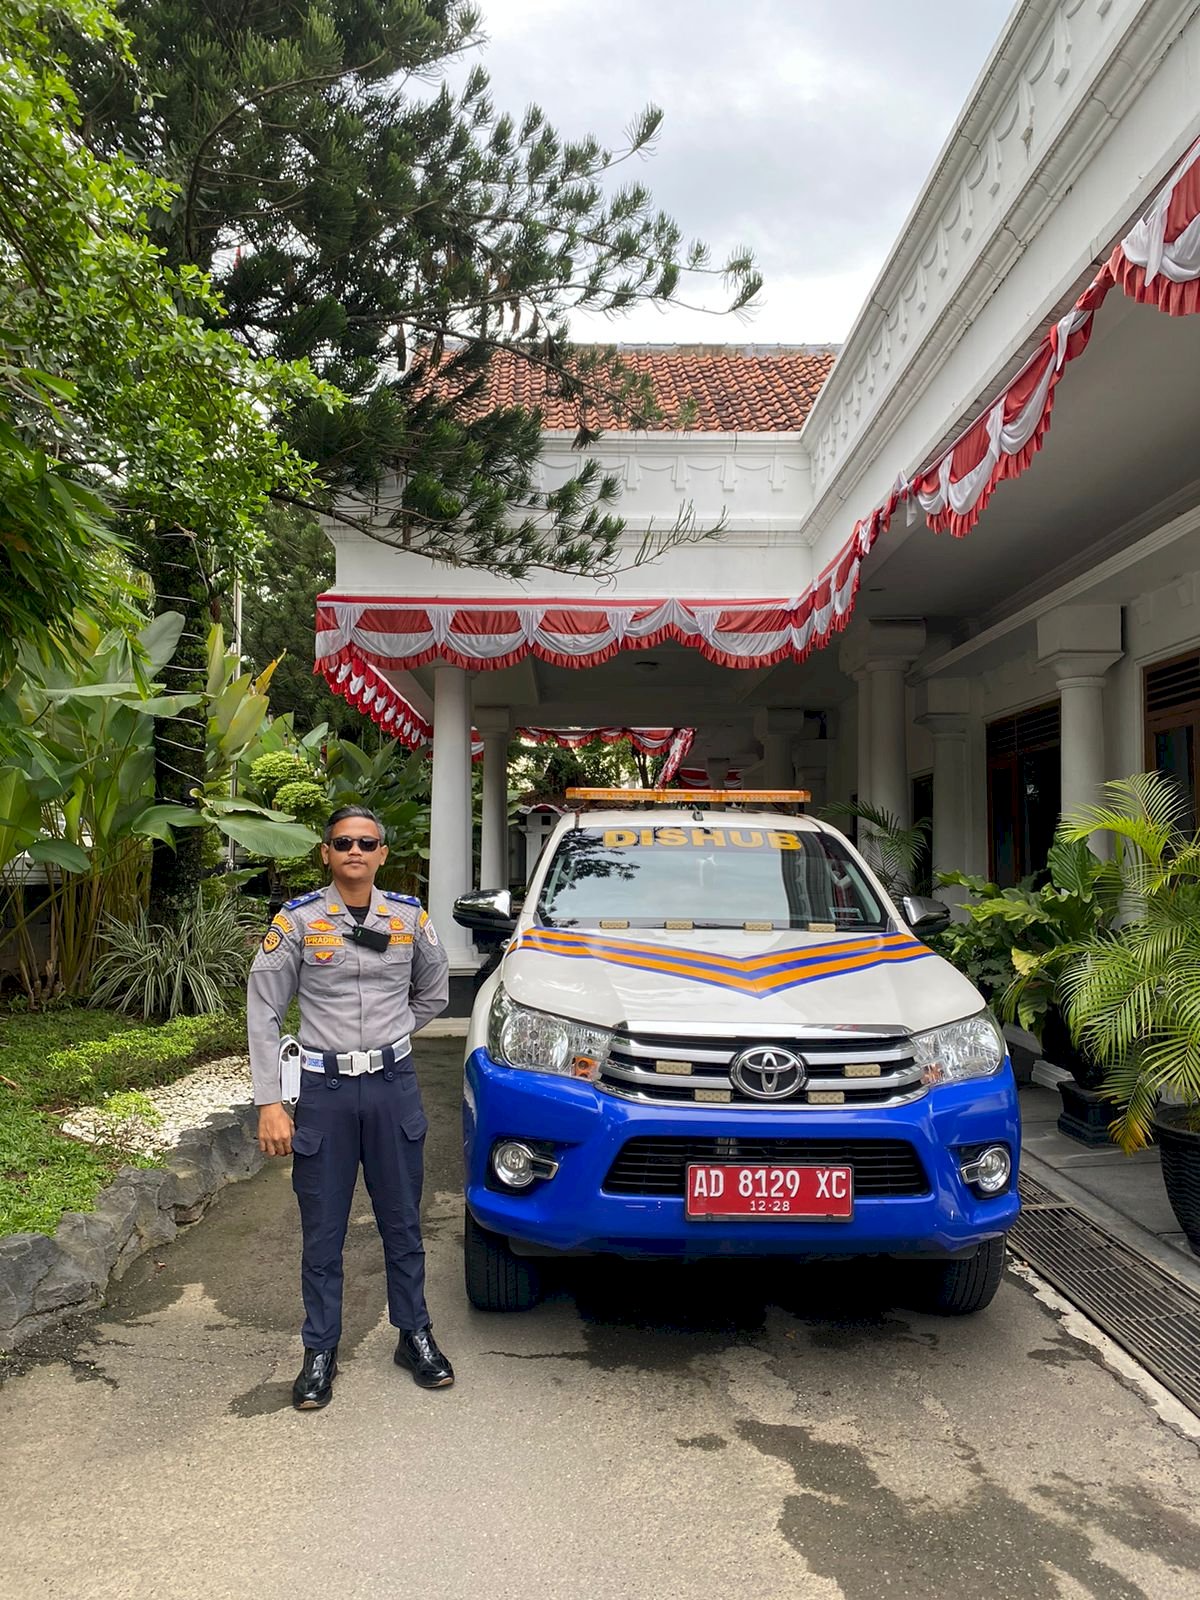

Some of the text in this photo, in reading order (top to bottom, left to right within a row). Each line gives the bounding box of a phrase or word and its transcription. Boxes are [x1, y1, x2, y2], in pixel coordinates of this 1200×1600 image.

[603, 828, 802, 850] DISHUB
[693, 1169, 847, 1198] AD 8129 XC
